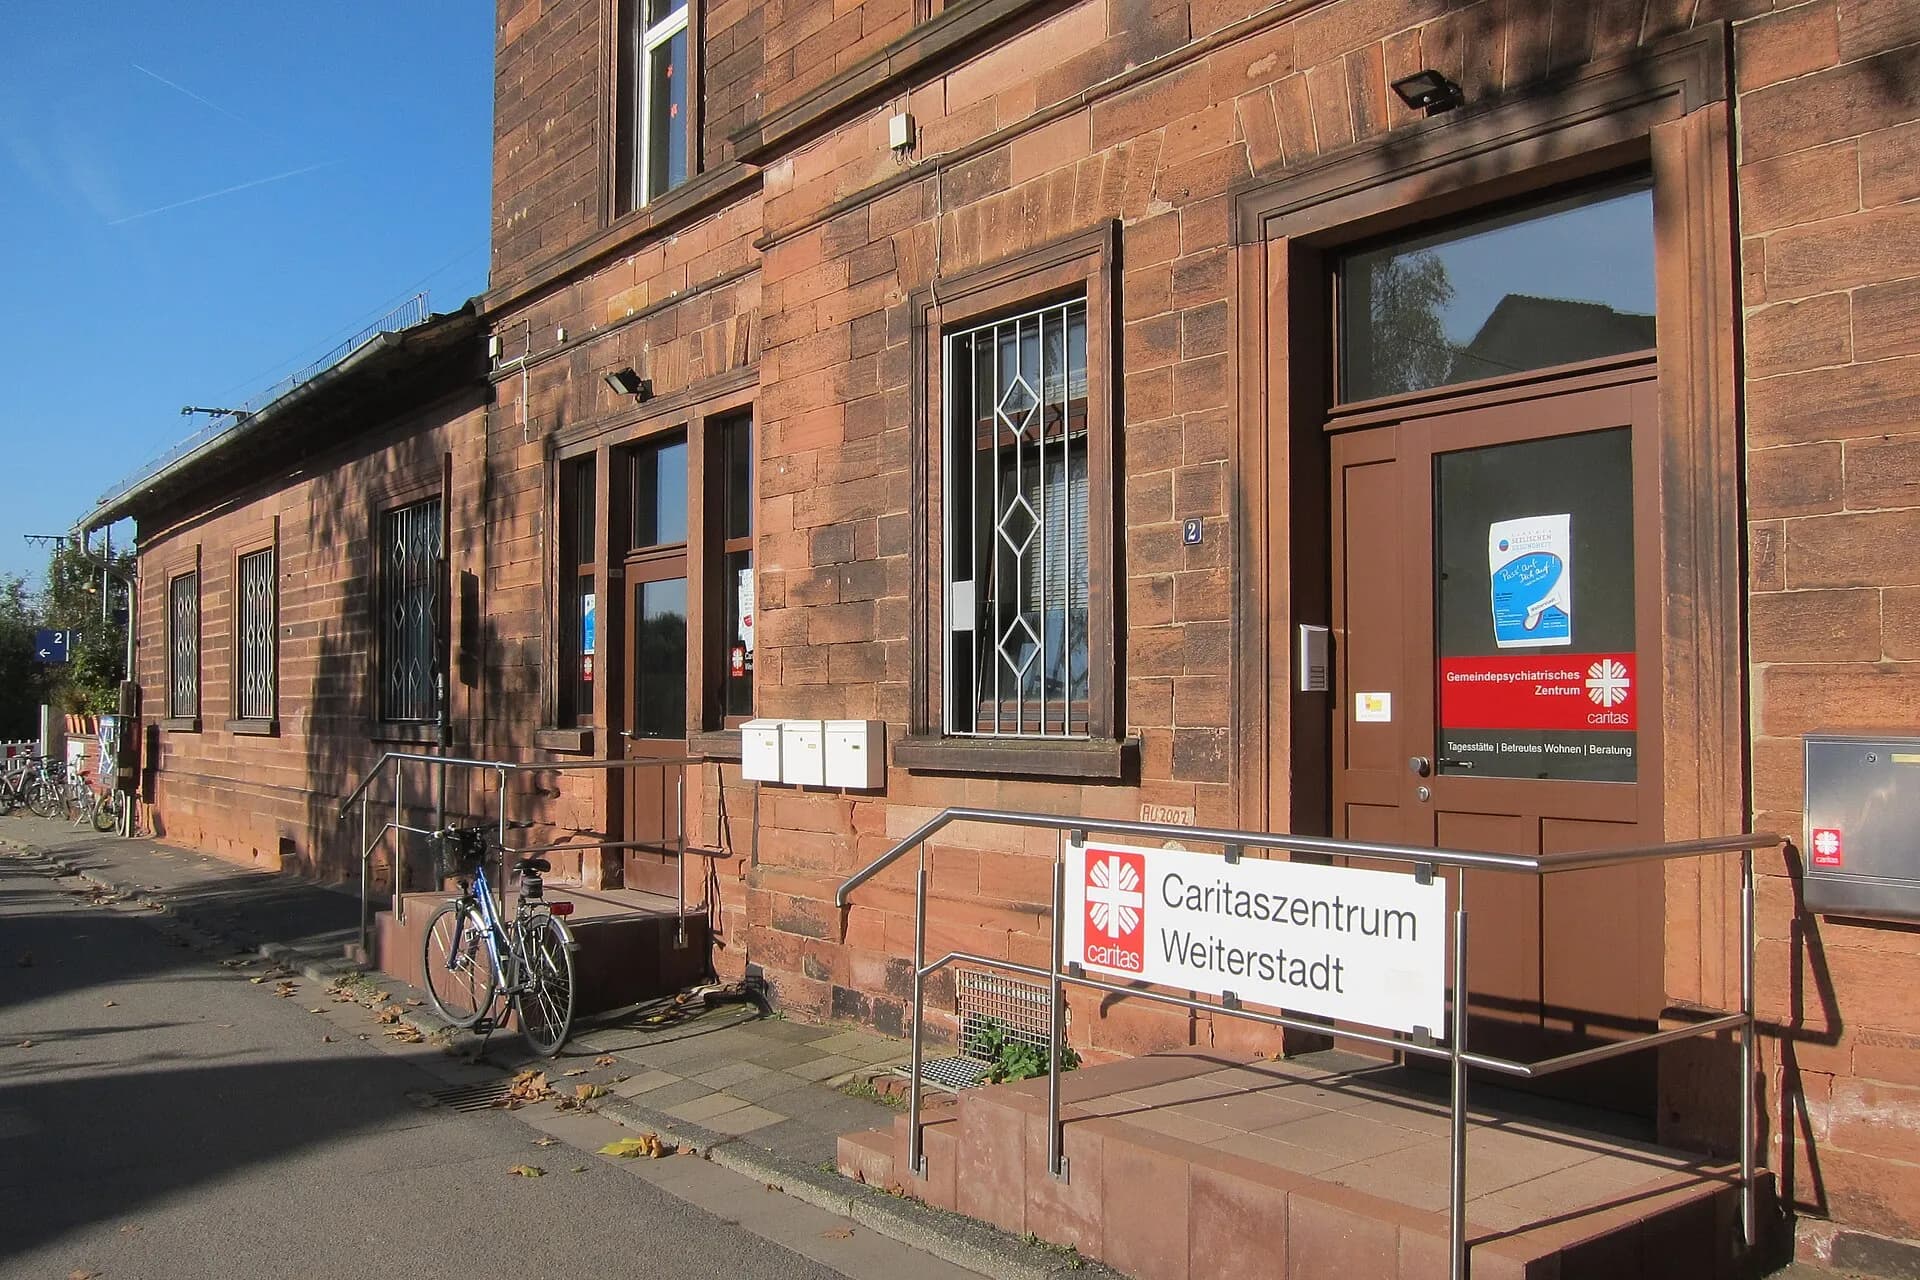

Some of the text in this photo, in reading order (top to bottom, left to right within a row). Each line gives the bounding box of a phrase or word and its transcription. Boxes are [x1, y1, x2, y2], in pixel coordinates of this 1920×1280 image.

[1187, 522, 1196, 541] 2
[54, 632, 63, 644] 2
[1446, 670, 1581, 684] Gemeindepsychiatrisches
[1534, 685, 1581, 696] Zentrum
[1587, 710, 1629, 724] caritas
[1447, 741, 1494, 755] Tagesstätte
[1501, 742, 1542, 753] Betreutes
[1543, 743, 1582, 754] Wohnen
[1589, 744, 1632, 757] Beratung
[1162, 872, 1417, 942] Caritaszentrum
[1087, 943, 1139, 969] caritas
[1161, 927, 1344, 994] Weiterstadt
